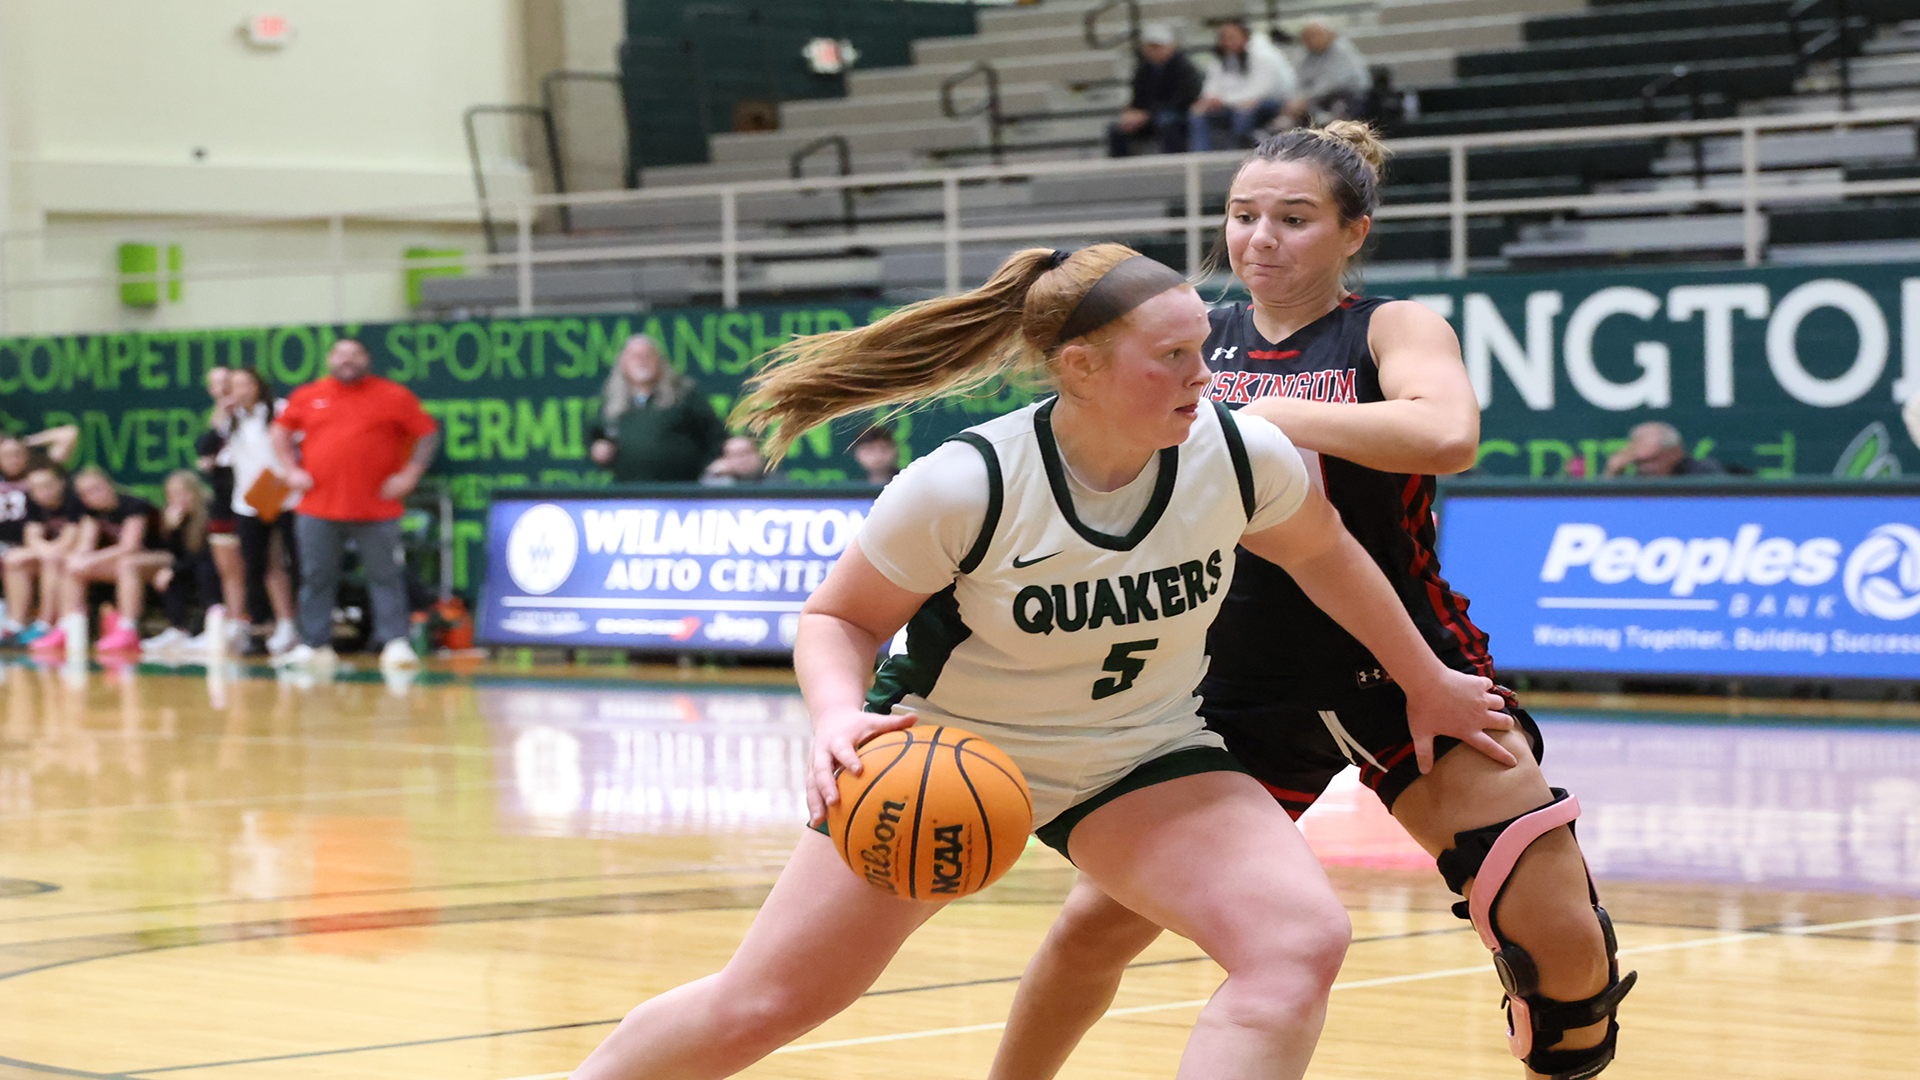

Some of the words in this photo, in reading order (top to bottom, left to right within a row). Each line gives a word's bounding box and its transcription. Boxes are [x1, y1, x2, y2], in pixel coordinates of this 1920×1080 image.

[1410, 277, 1920, 412] NGTO
[604, 558, 702, 592] AUTO
[708, 559, 839, 594] CENTE
[1013, 549, 1222, 635] QUAKERS
[1540, 523, 1842, 597] Peoples
[1727, 593, 1838, 619] BANK
[1091, 638, 1159, 701] 5
[930, 823, 964, 894] NCAA
